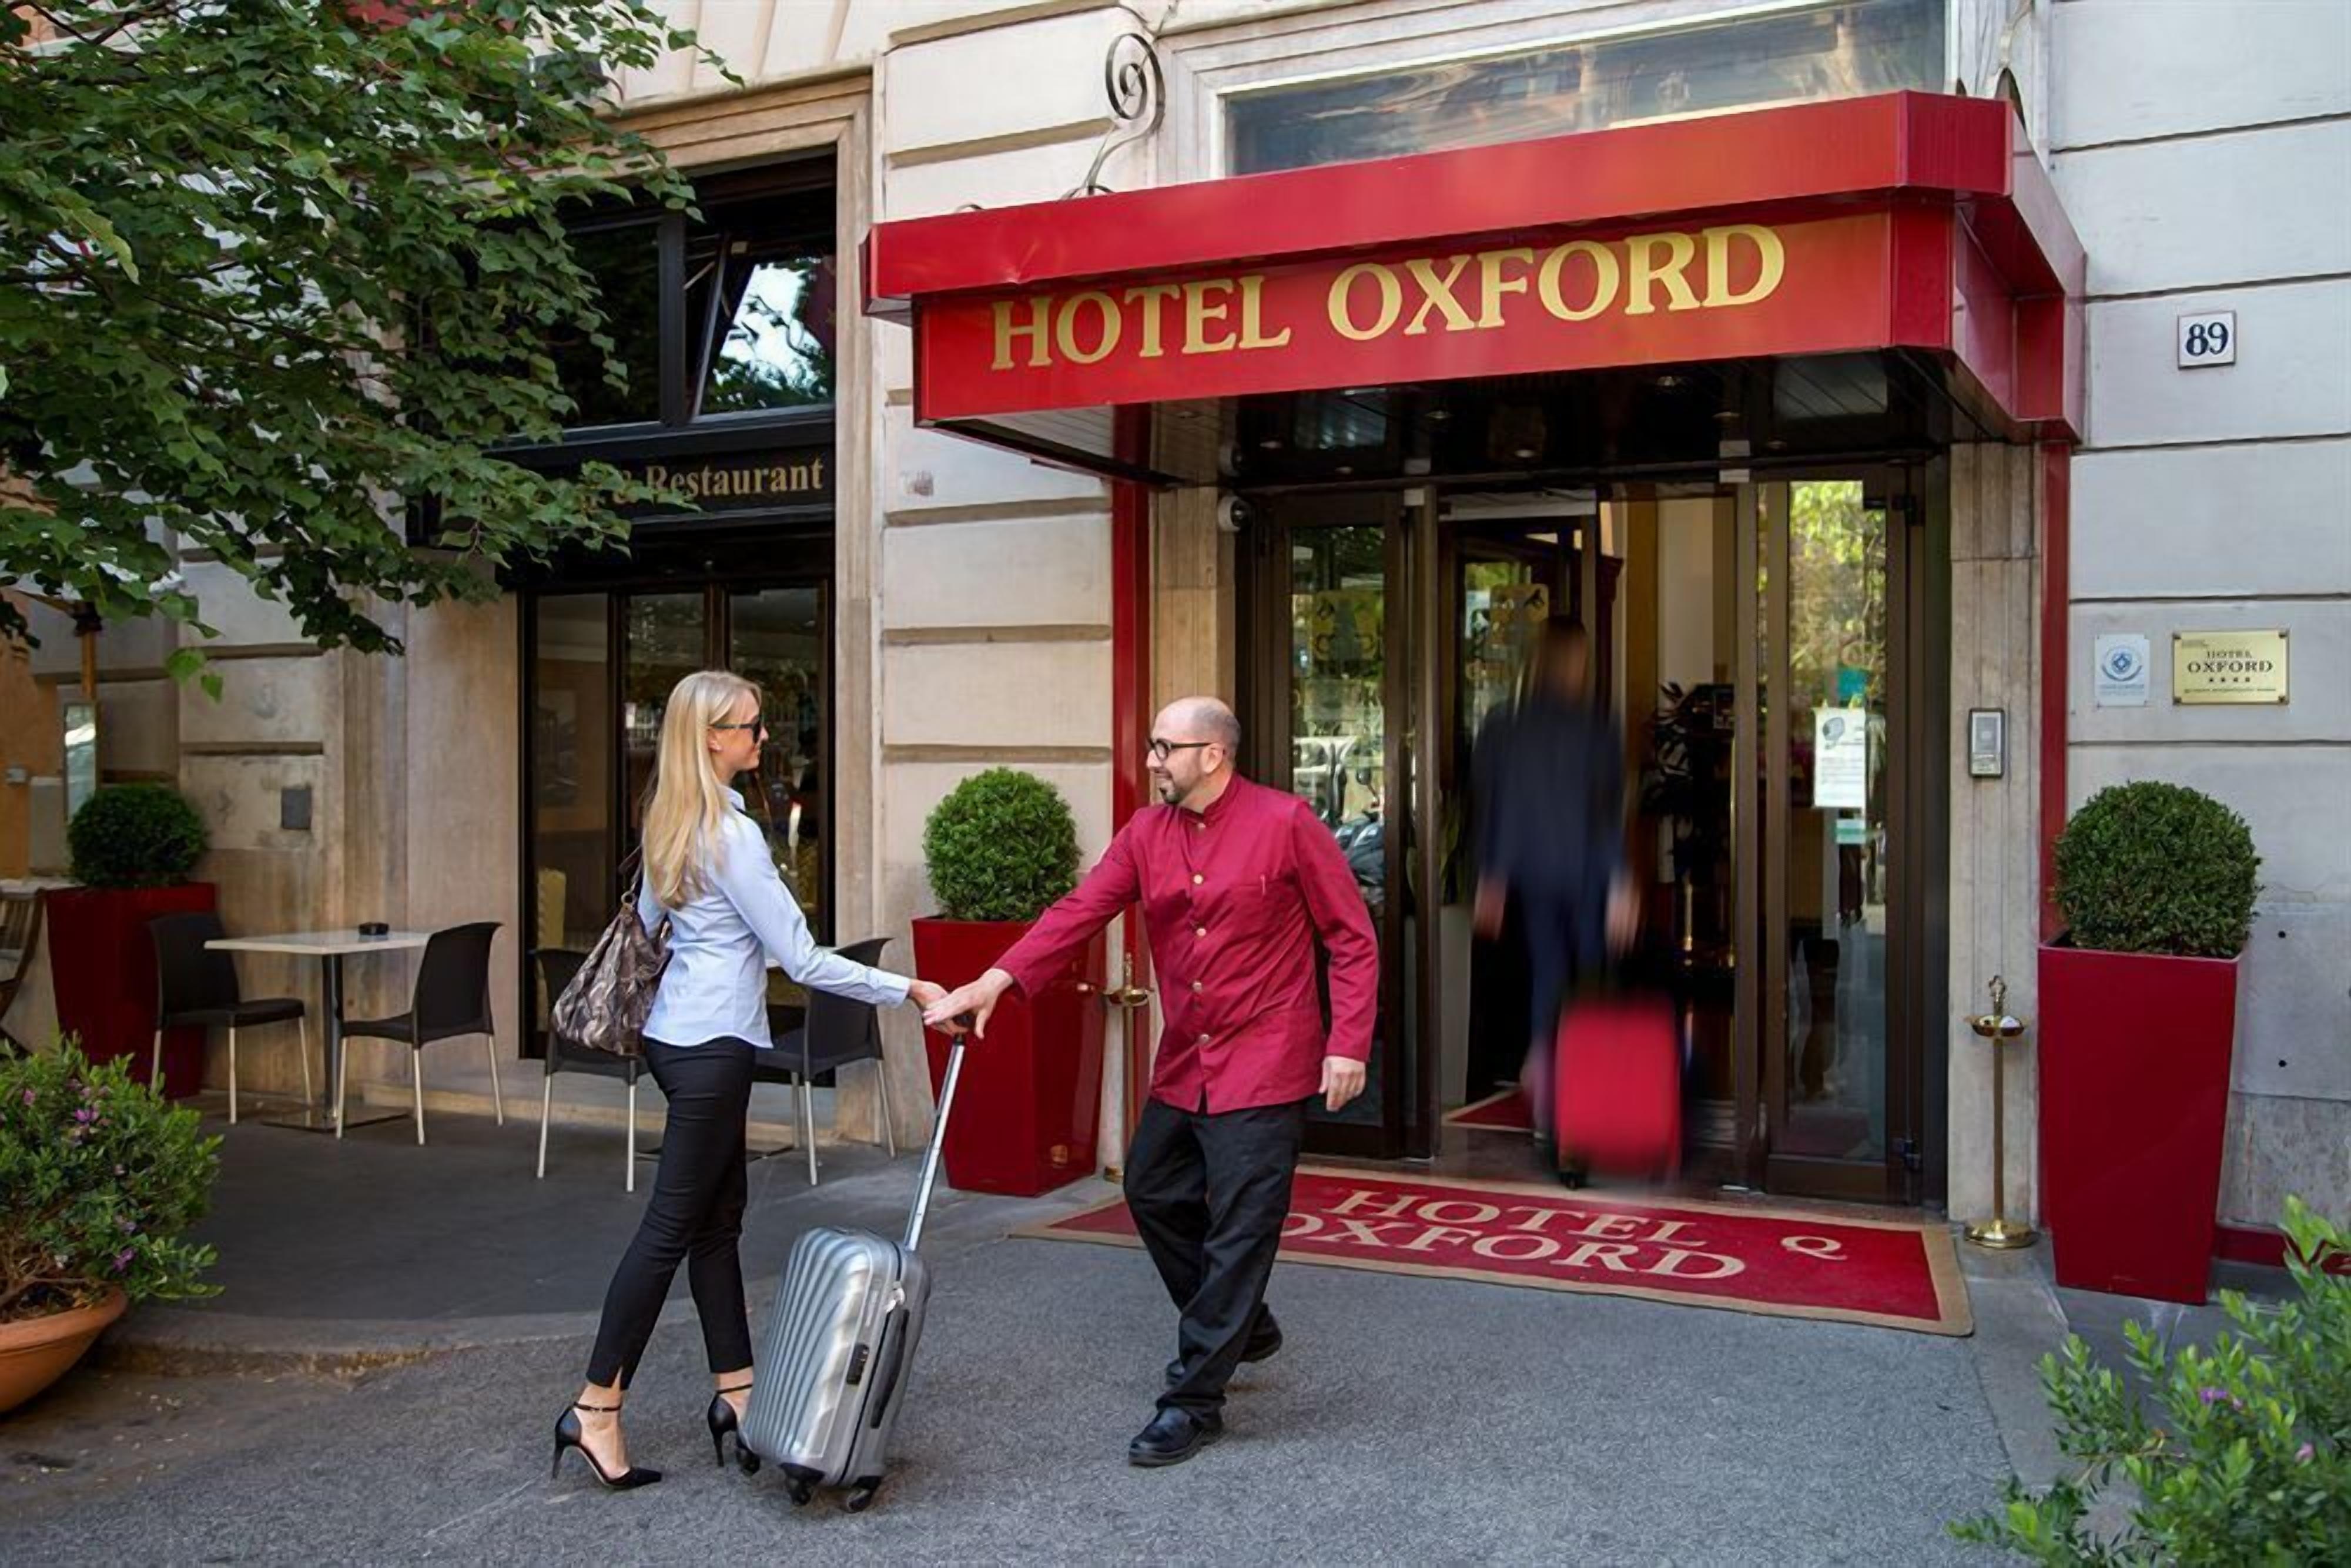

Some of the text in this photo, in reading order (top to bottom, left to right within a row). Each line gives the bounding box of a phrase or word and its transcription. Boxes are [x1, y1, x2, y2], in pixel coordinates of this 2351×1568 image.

[991, 223, 1785, 370] HOTEL OXFORD
[2186, 321, 2229, 357] 89
[646, 457, 824, 500] Restaurant
[2187, 660, 2273, 674] OXFORD
[1321, 1190, 1707, 1247] HOTEL
